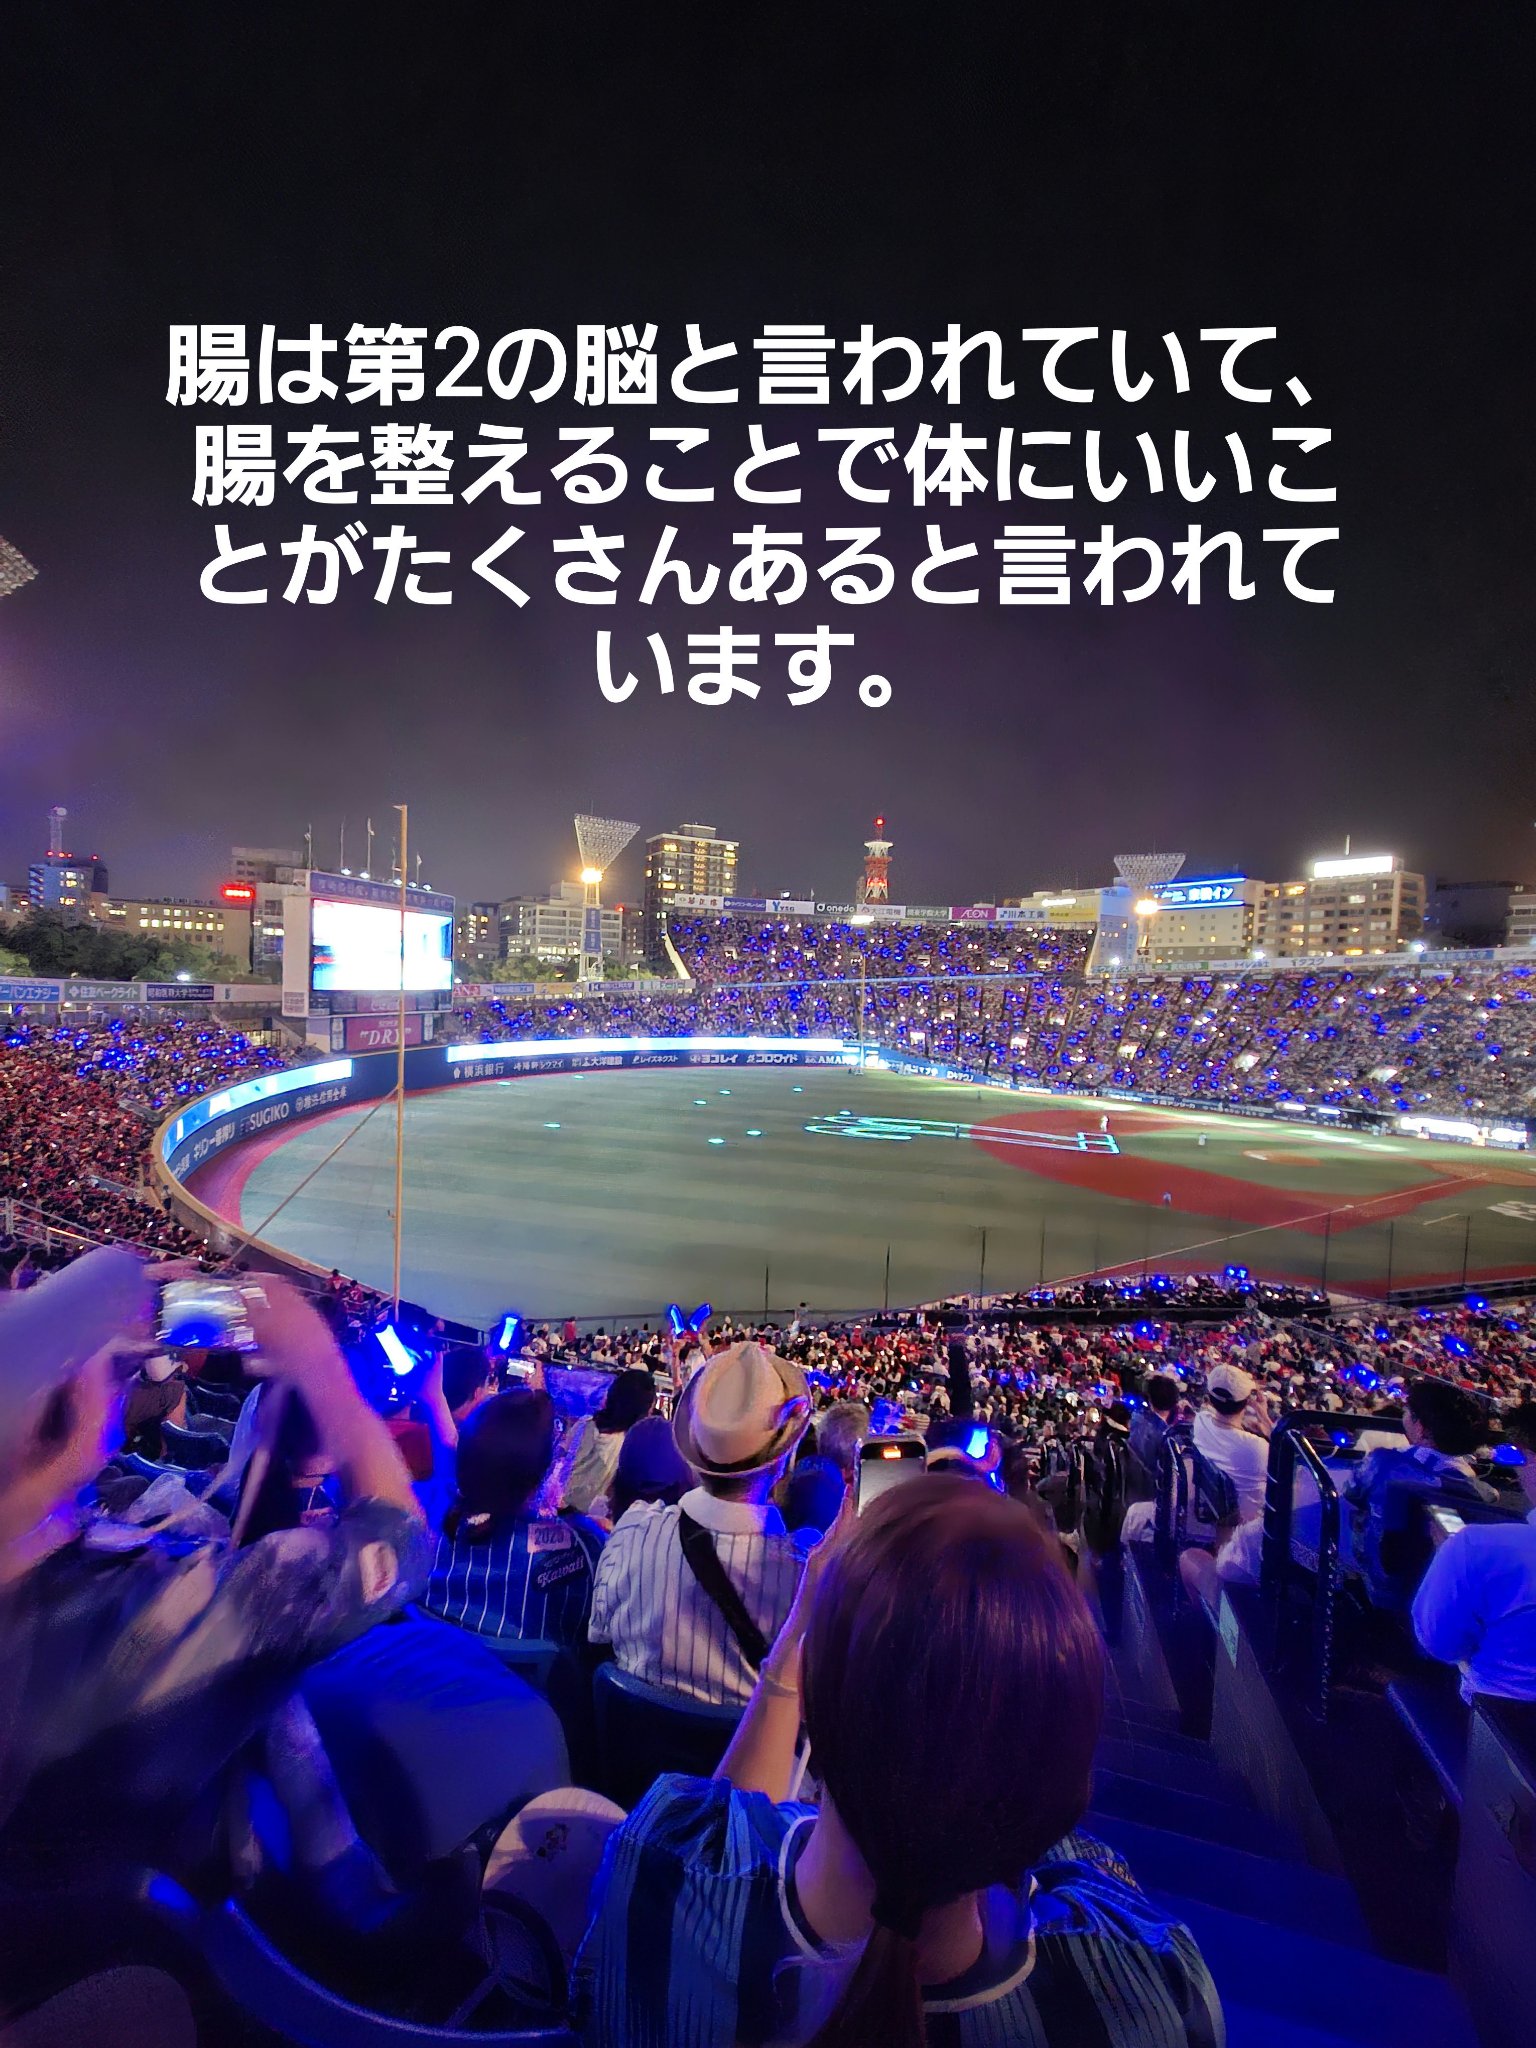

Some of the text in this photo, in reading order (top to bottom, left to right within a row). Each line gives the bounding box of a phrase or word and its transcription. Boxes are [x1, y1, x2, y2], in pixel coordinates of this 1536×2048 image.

[826, 903, 855, 913] onedo
[464, 1062, 505, 1079] 横浜銀行
[249, 1102, 290, 1131] SUGIKO
